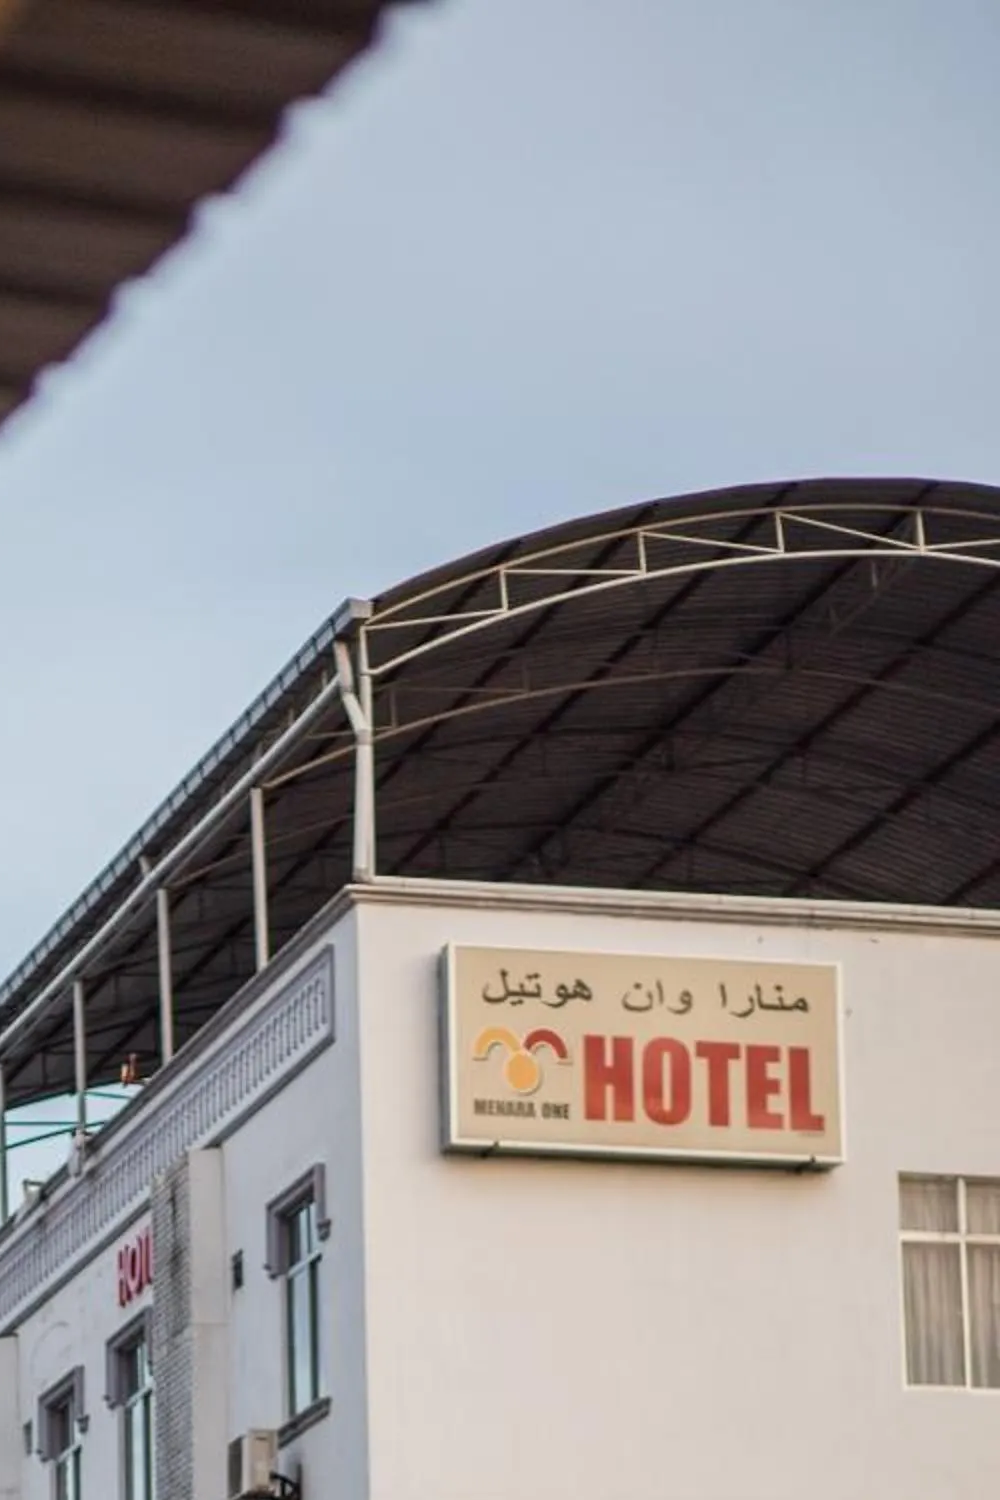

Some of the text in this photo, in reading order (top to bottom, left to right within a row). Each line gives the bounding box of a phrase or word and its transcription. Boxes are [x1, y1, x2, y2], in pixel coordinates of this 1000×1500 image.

[481, 968, 810, 1019] منارا وان هوتيل
[583, 1034, 826, 1132] HOTEL
[473, 1098, 570, 1120] MENARA ONE
